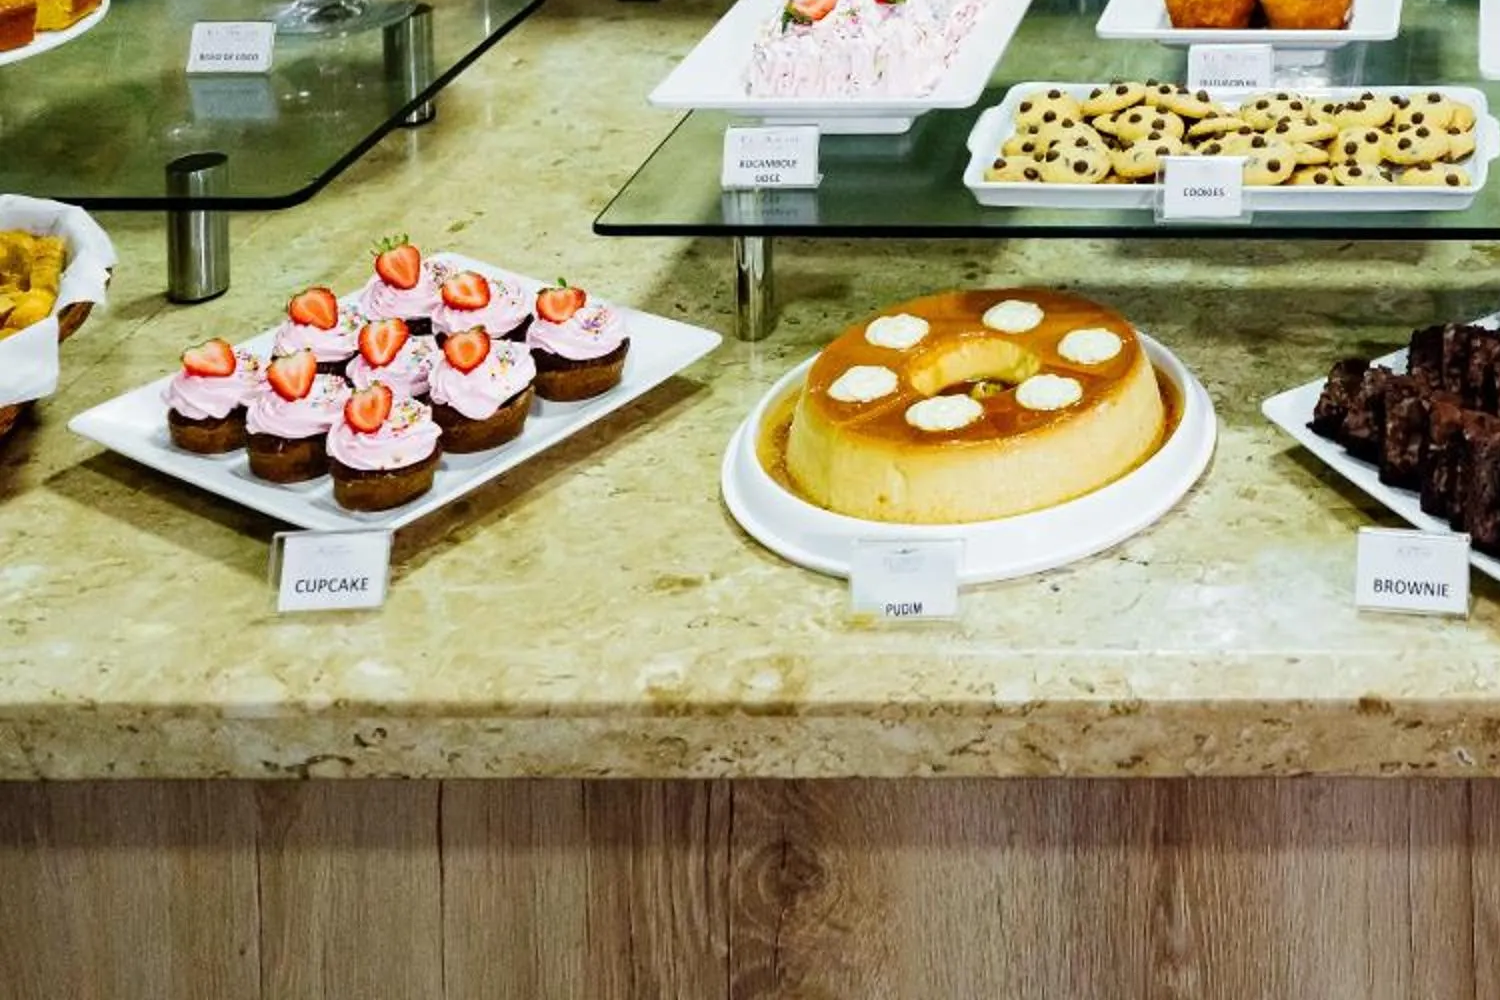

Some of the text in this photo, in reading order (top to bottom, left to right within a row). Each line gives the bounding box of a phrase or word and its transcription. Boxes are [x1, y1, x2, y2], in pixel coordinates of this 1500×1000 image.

[1183, 187, 1225, 198] COOKIES
[294, 577, 369, 593] CUPCAKE
[1373, 578, 1450, 598] BROWNIE
[885, 601, 924, 617] PUDIM
